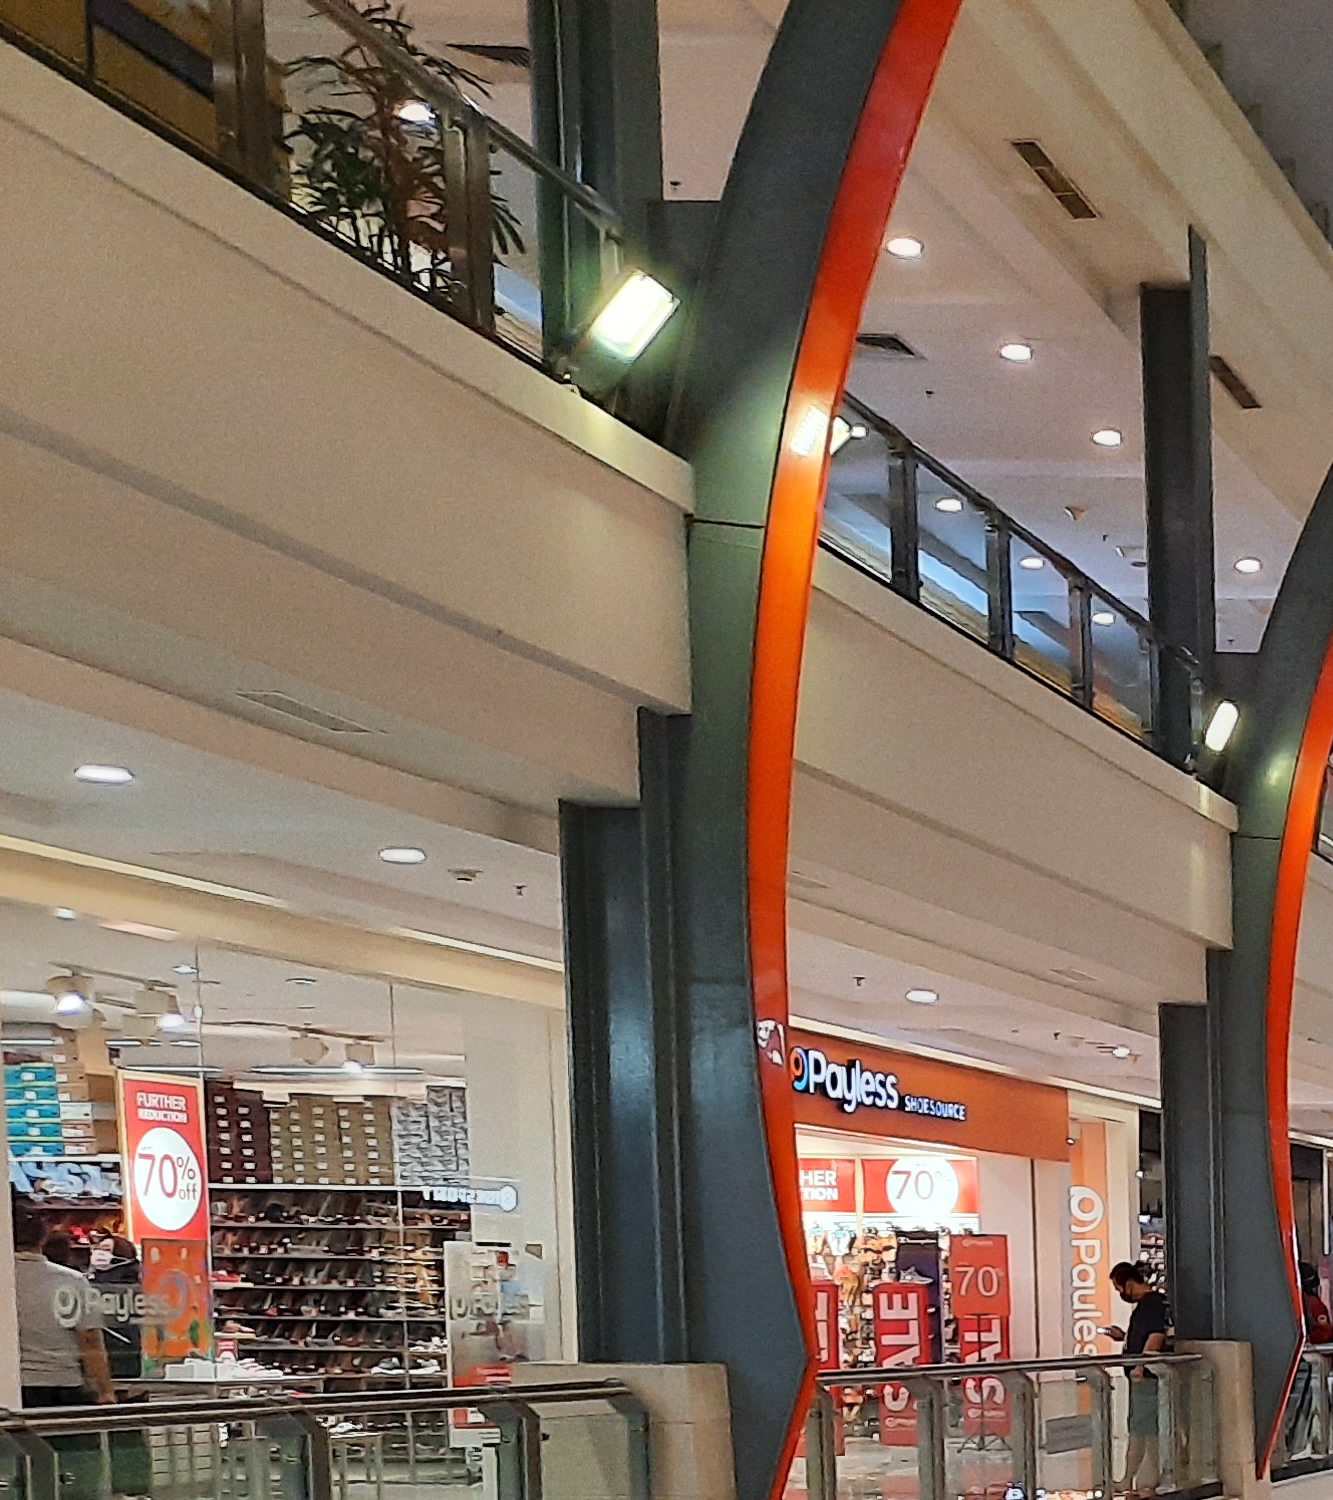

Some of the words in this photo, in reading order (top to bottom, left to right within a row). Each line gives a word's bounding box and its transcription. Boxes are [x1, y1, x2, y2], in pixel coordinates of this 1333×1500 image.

[137, 1091, 187, 1112] FURTHER
[808, 1050, 899, 1113] Payless
[904, 1095, 967, 1121] SHOESOURCE
